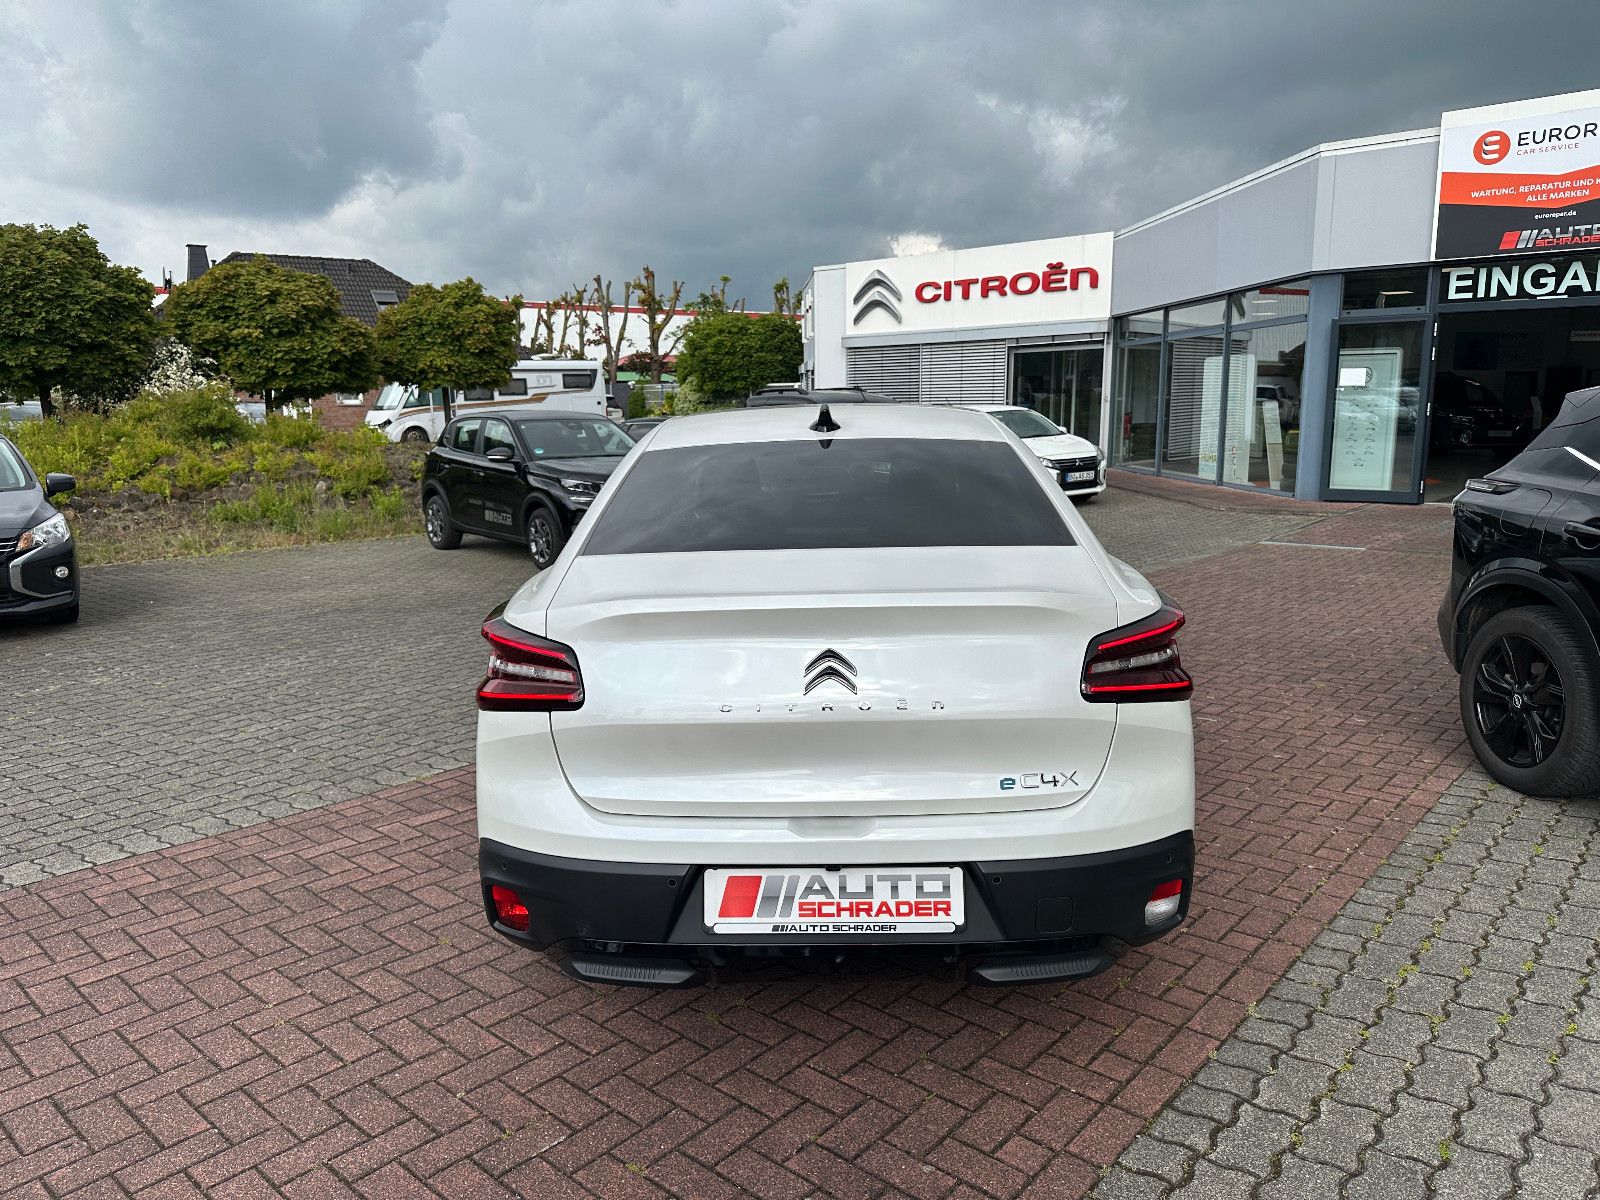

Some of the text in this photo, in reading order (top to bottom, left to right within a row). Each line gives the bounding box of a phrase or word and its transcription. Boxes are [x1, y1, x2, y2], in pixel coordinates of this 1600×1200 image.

[1517, 122, 1598, 147] EUROR
[1516, 142, 1580, 156] CAR SERVICE
[1471, 186, 1517, 199] WARTUNG,
[1519, 179, 1571, 194] REPARATUR
[1573, 177, 1594, 188] UND
[1526, 188, 1590, 203] ALLE MARKEN
[1448, 260, 1600, 300] EINGA
[800, 874, 951, 900] AUTO
[798, 900, 952, 918] SCHRADER
[788, 924, 897, 932] AUTO SCHRADER
